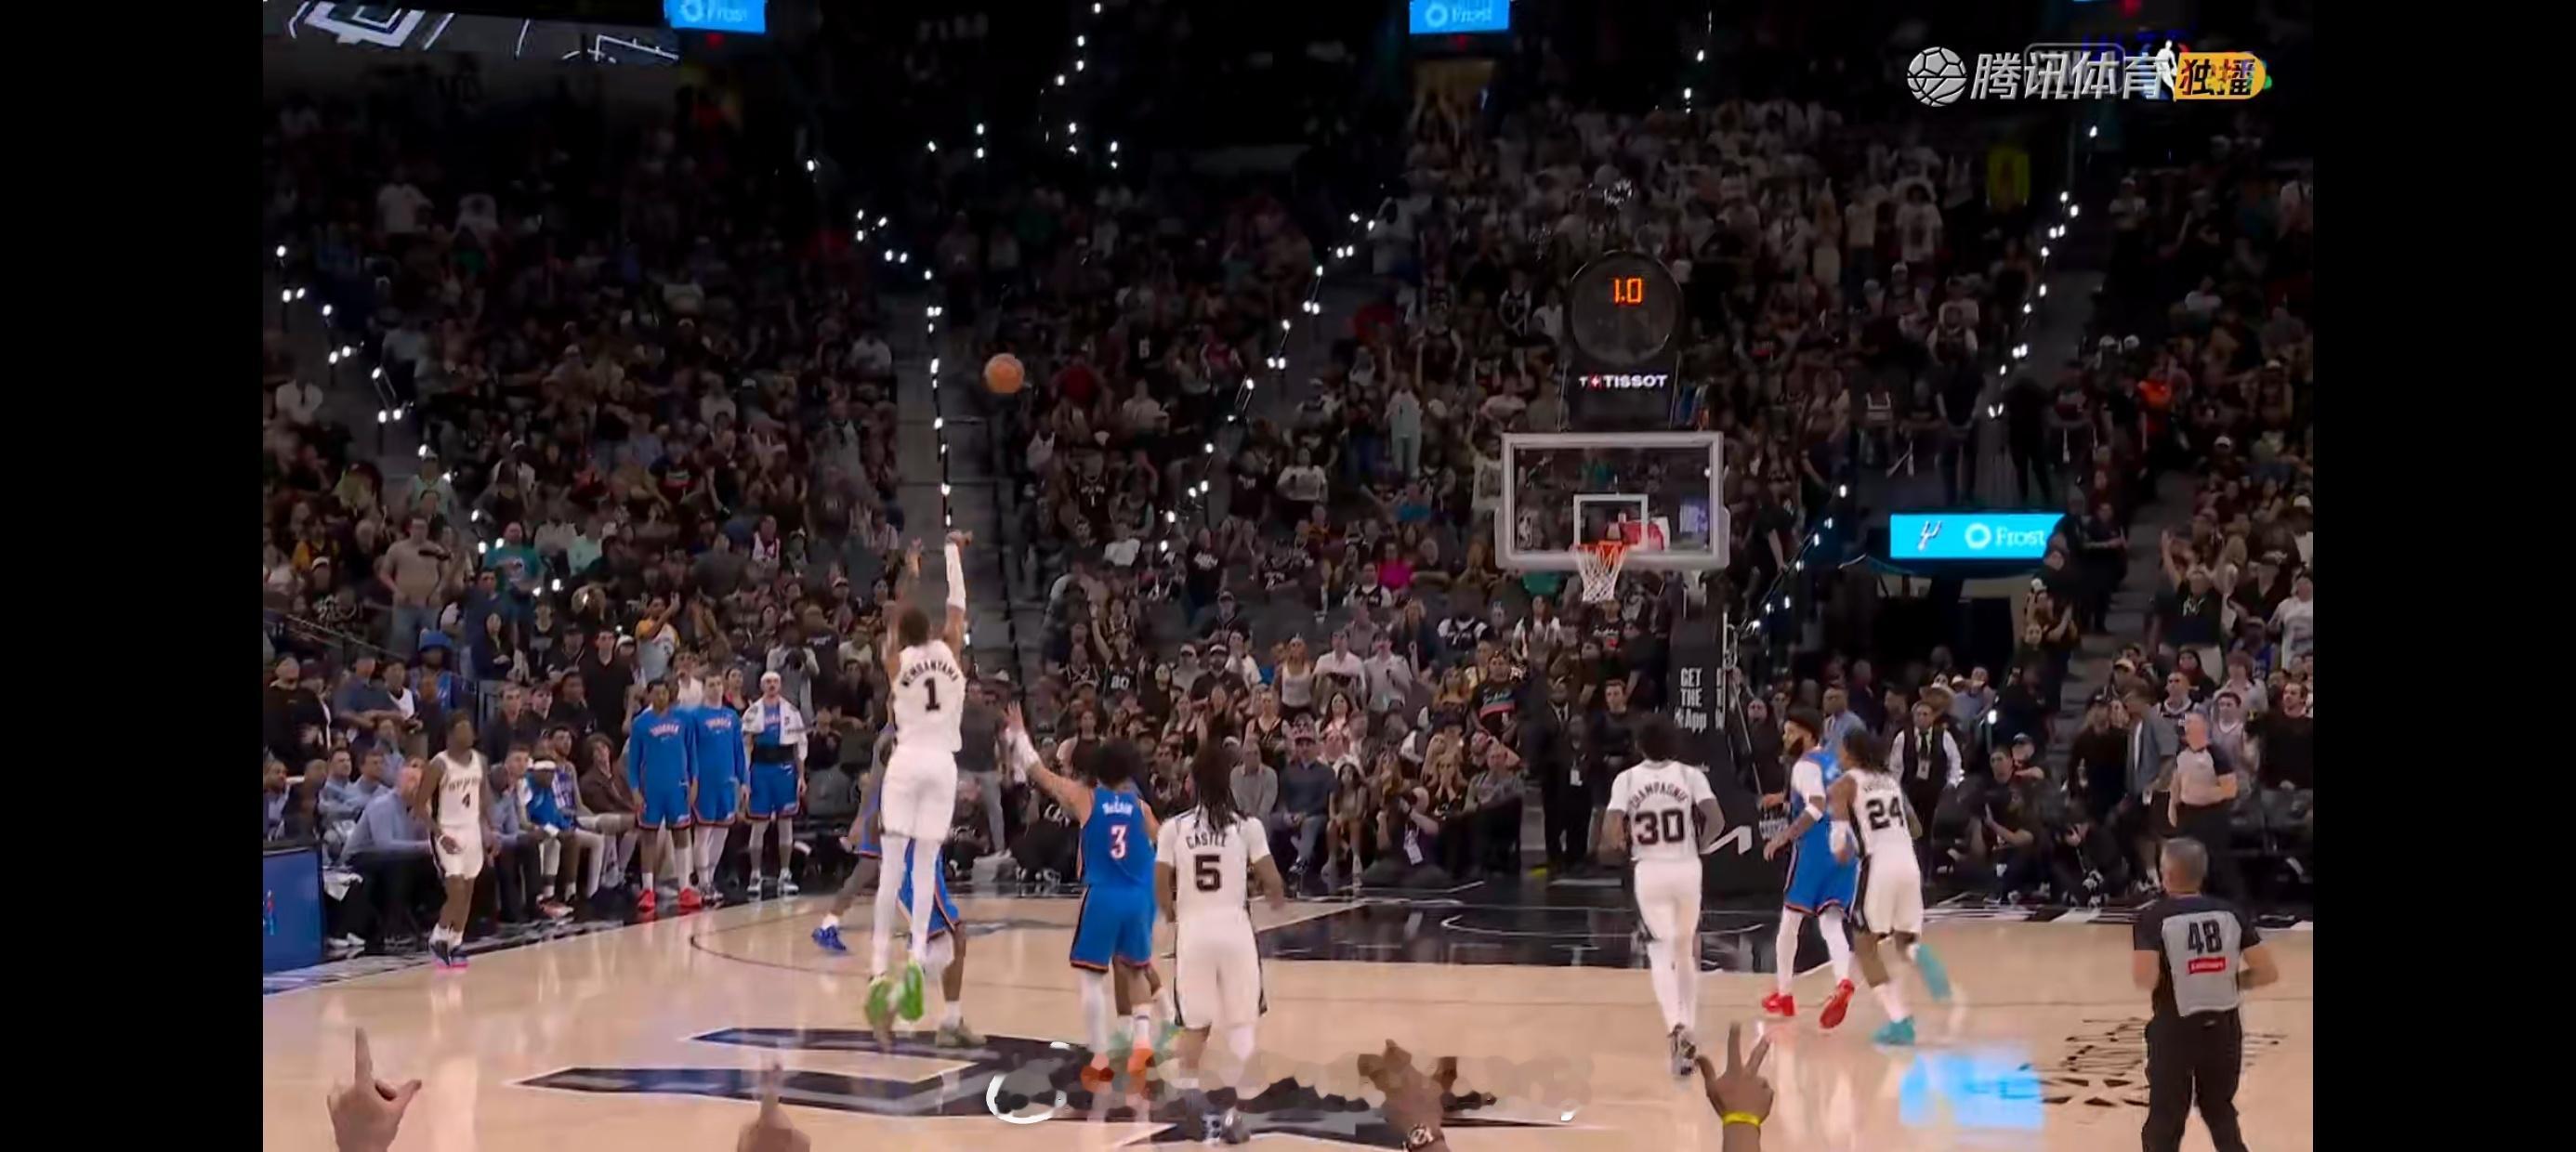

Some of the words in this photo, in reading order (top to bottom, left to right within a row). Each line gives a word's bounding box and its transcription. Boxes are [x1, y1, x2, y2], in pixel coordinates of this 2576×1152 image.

[1614, 278, 1642, 304] 1.0
[1603, 373, 1669, 388] TISSOT
[1997, 526, 2045, 546] Frost
[1680, 667, 1702, 687] GET
[924, 676, 940, 712] 1
[1680, 687, 1702, 708] THE
[461, 792, 471, 808] 4
[1866, 796, 1905, 831] 24
[1110, 824, 1128, 859] 3
[1635, 807, 1685, 846] 30
[1194, 854, 1222, 892] 5
[2188, 919, 2223, 954] 48
